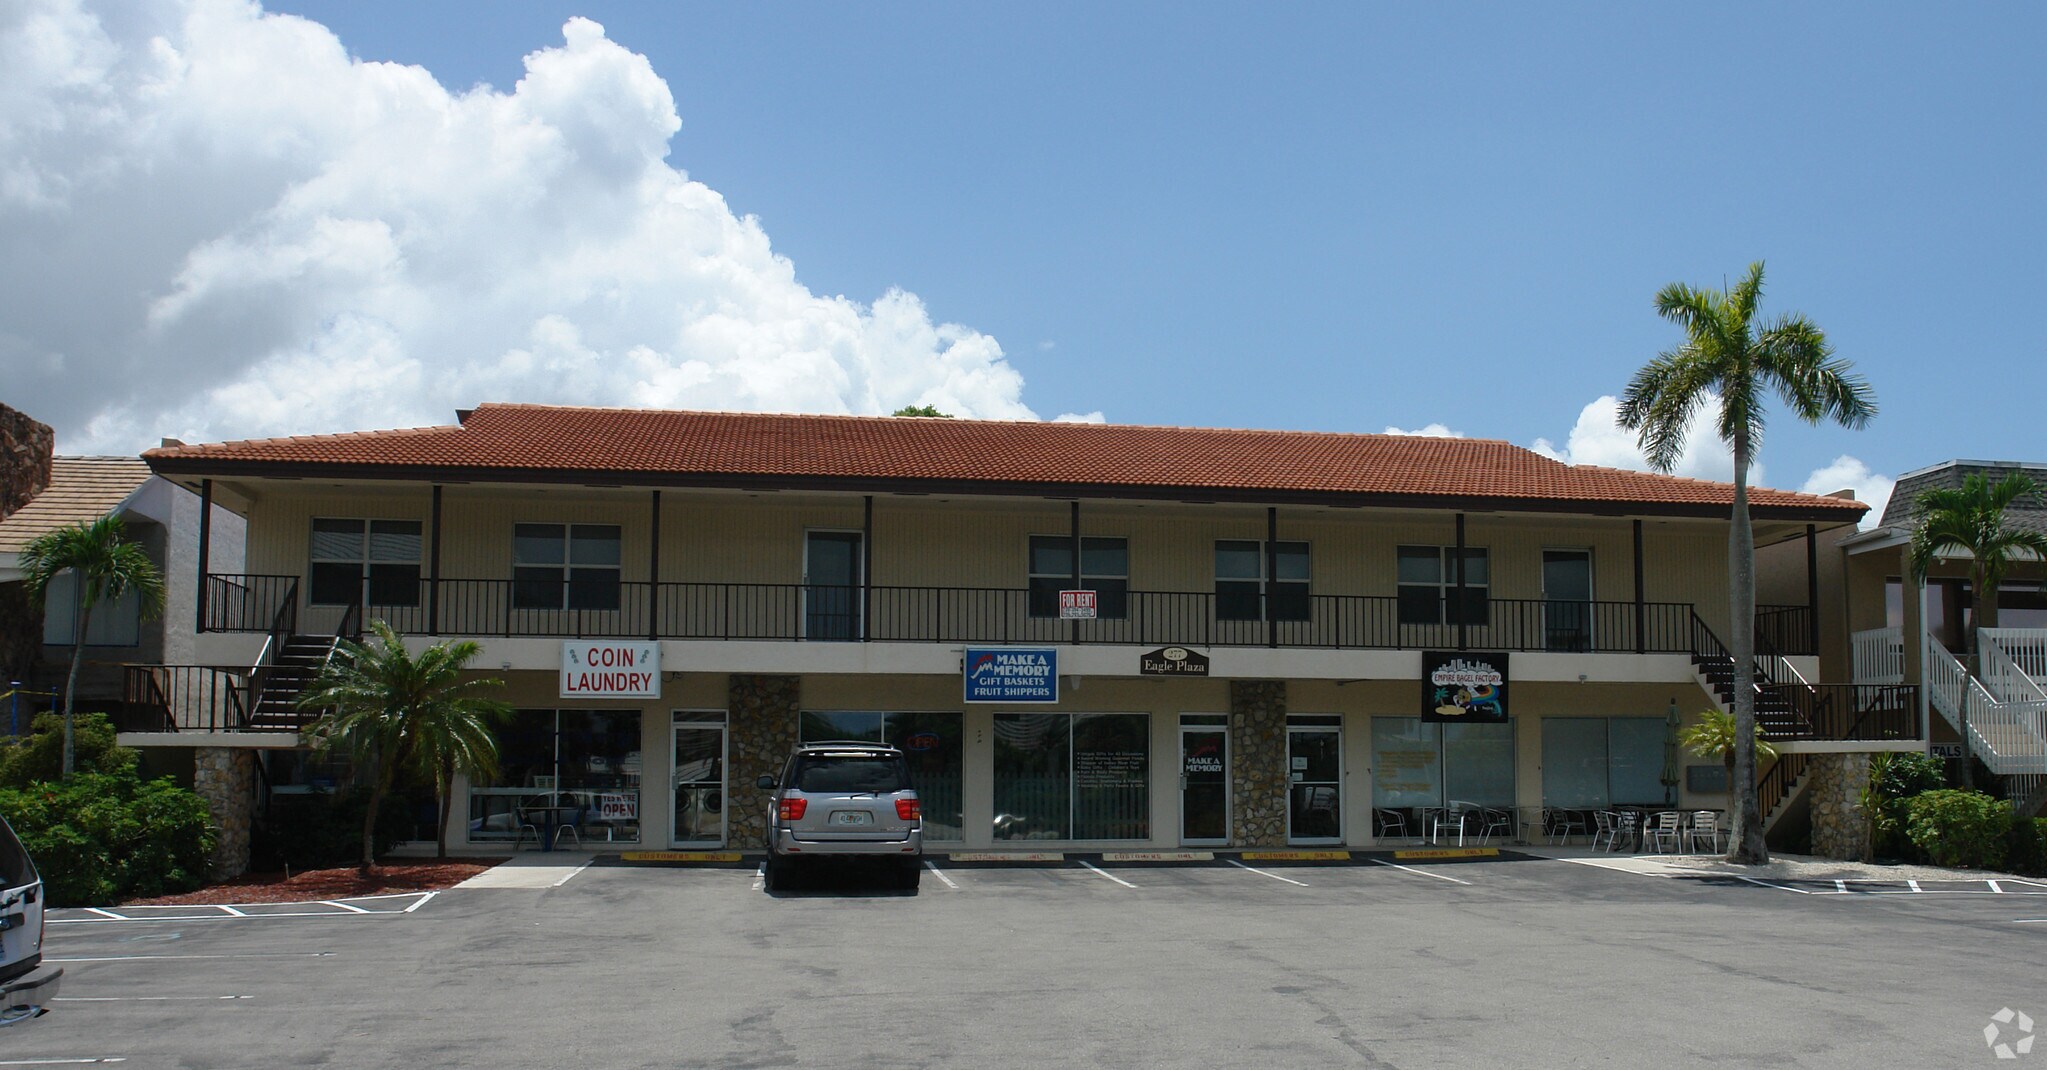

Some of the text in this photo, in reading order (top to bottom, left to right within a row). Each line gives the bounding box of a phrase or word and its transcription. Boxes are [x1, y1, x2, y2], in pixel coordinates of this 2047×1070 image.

[1062, 593, 1094, 607] FOR RENT
[587, 647, 634, 667] COIN
[996, 654, 1047, 665] MAKE A
[1168, 650, 1182, 658] 277
[993, 665, 1051, 676] MEMORY
[1144, 660, 1205, 673] Eagle Plaza
[567, 672, 652, 691] LAUNDRY
[979, 677, 1045, 686] GIFT BASKETS
[1434, 674, 1500, 683] EMPIRE BAGEL FACTORY
[974, 687, 1050, 696] FRUIT SHIPPERS
[1187, 757, 1221, 765] MAKE A
[1185, 764, 1223, 772] MEMORY
[603, 803, 636, 817] OPEN
